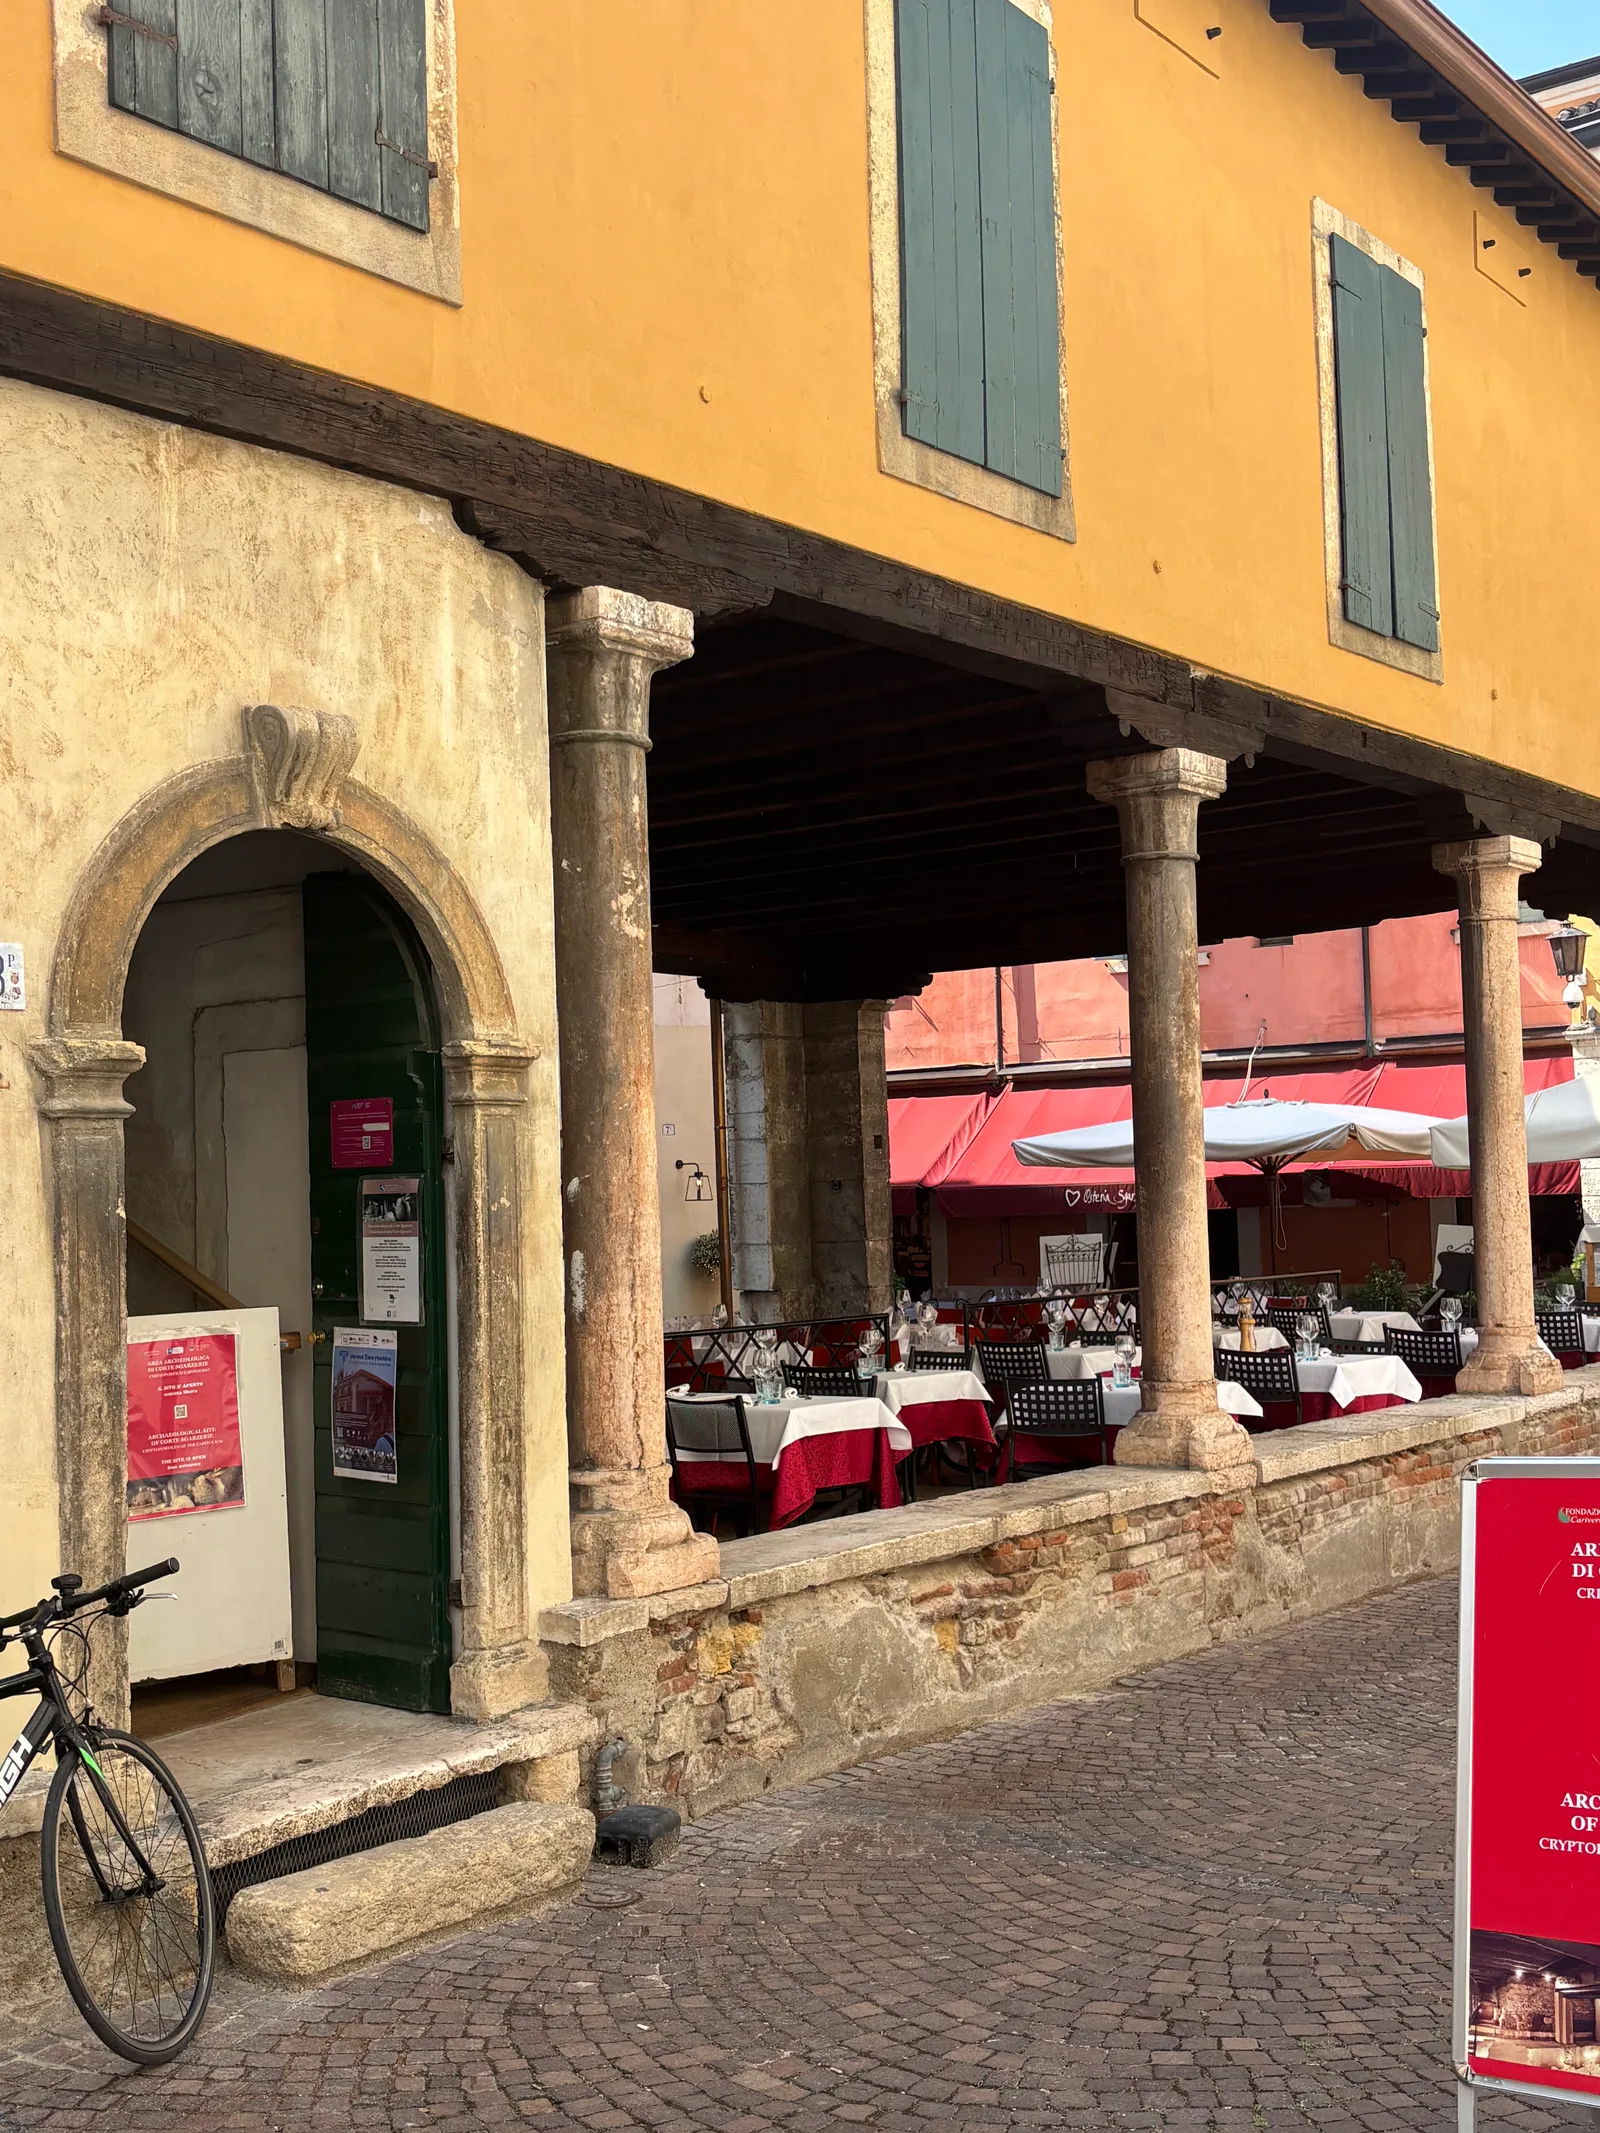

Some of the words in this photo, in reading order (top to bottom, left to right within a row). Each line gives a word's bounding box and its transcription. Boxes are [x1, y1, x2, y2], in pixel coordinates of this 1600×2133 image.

[1083, 1188, 1117, 1205] Osteria
[1113, 1189, 1136, 1210] Sgar
[1565, 1507, 1600, 1515] FONDAZI
[1570, 1542, 1600, 1556] AR
[1572, 1563, 1594, 1578] DI
[1560, 1792, 1600, 1810] ARC
[1571, 1815, 1599, 1831] OF
